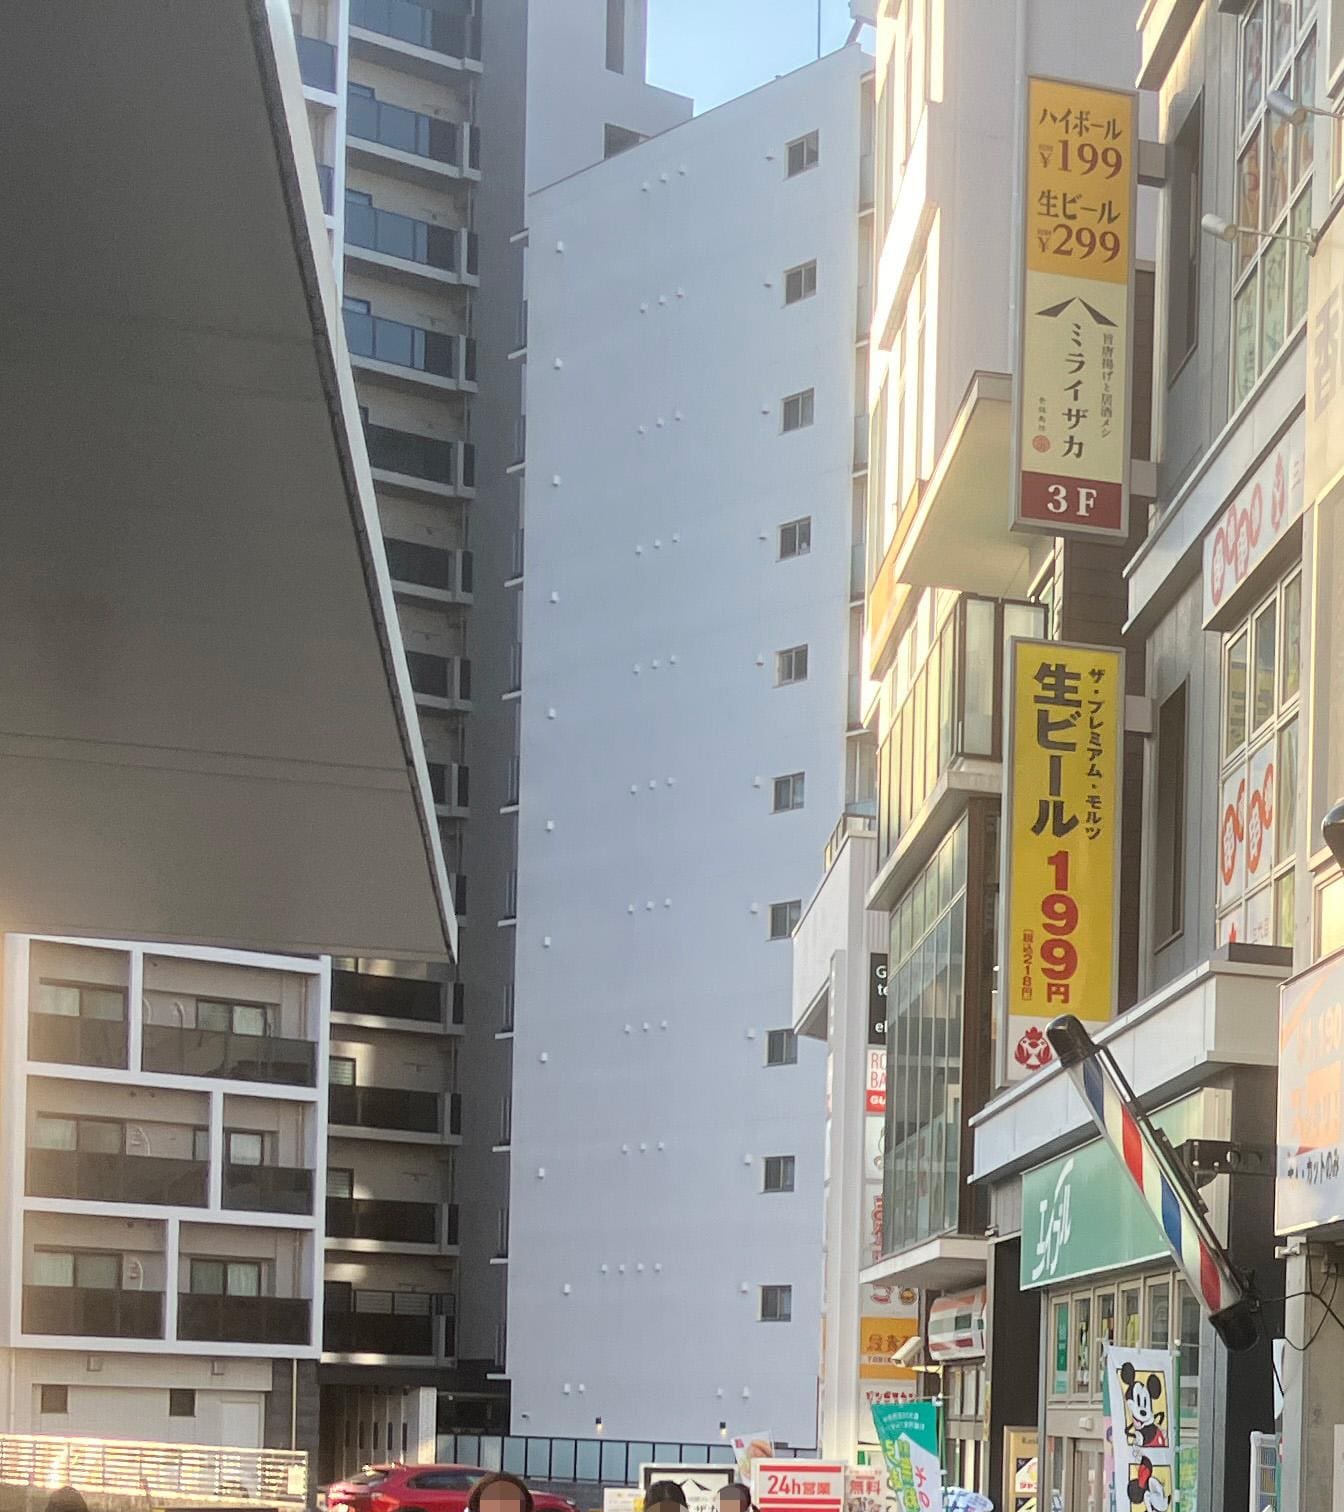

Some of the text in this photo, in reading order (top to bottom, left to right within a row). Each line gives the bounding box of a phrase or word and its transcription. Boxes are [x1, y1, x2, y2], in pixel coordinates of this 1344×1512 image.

[1039, 108, 1122, 140] ハイボール
[1037, 189, 1121, 225] 生ビール
[1061, 322, 1088, 459] ミライザカ
[1047, 484, 1097, 516] 3F
[1031, 662, 1082, 838] 生ビール
[768, 1474, 831, 1496] 24h営業
